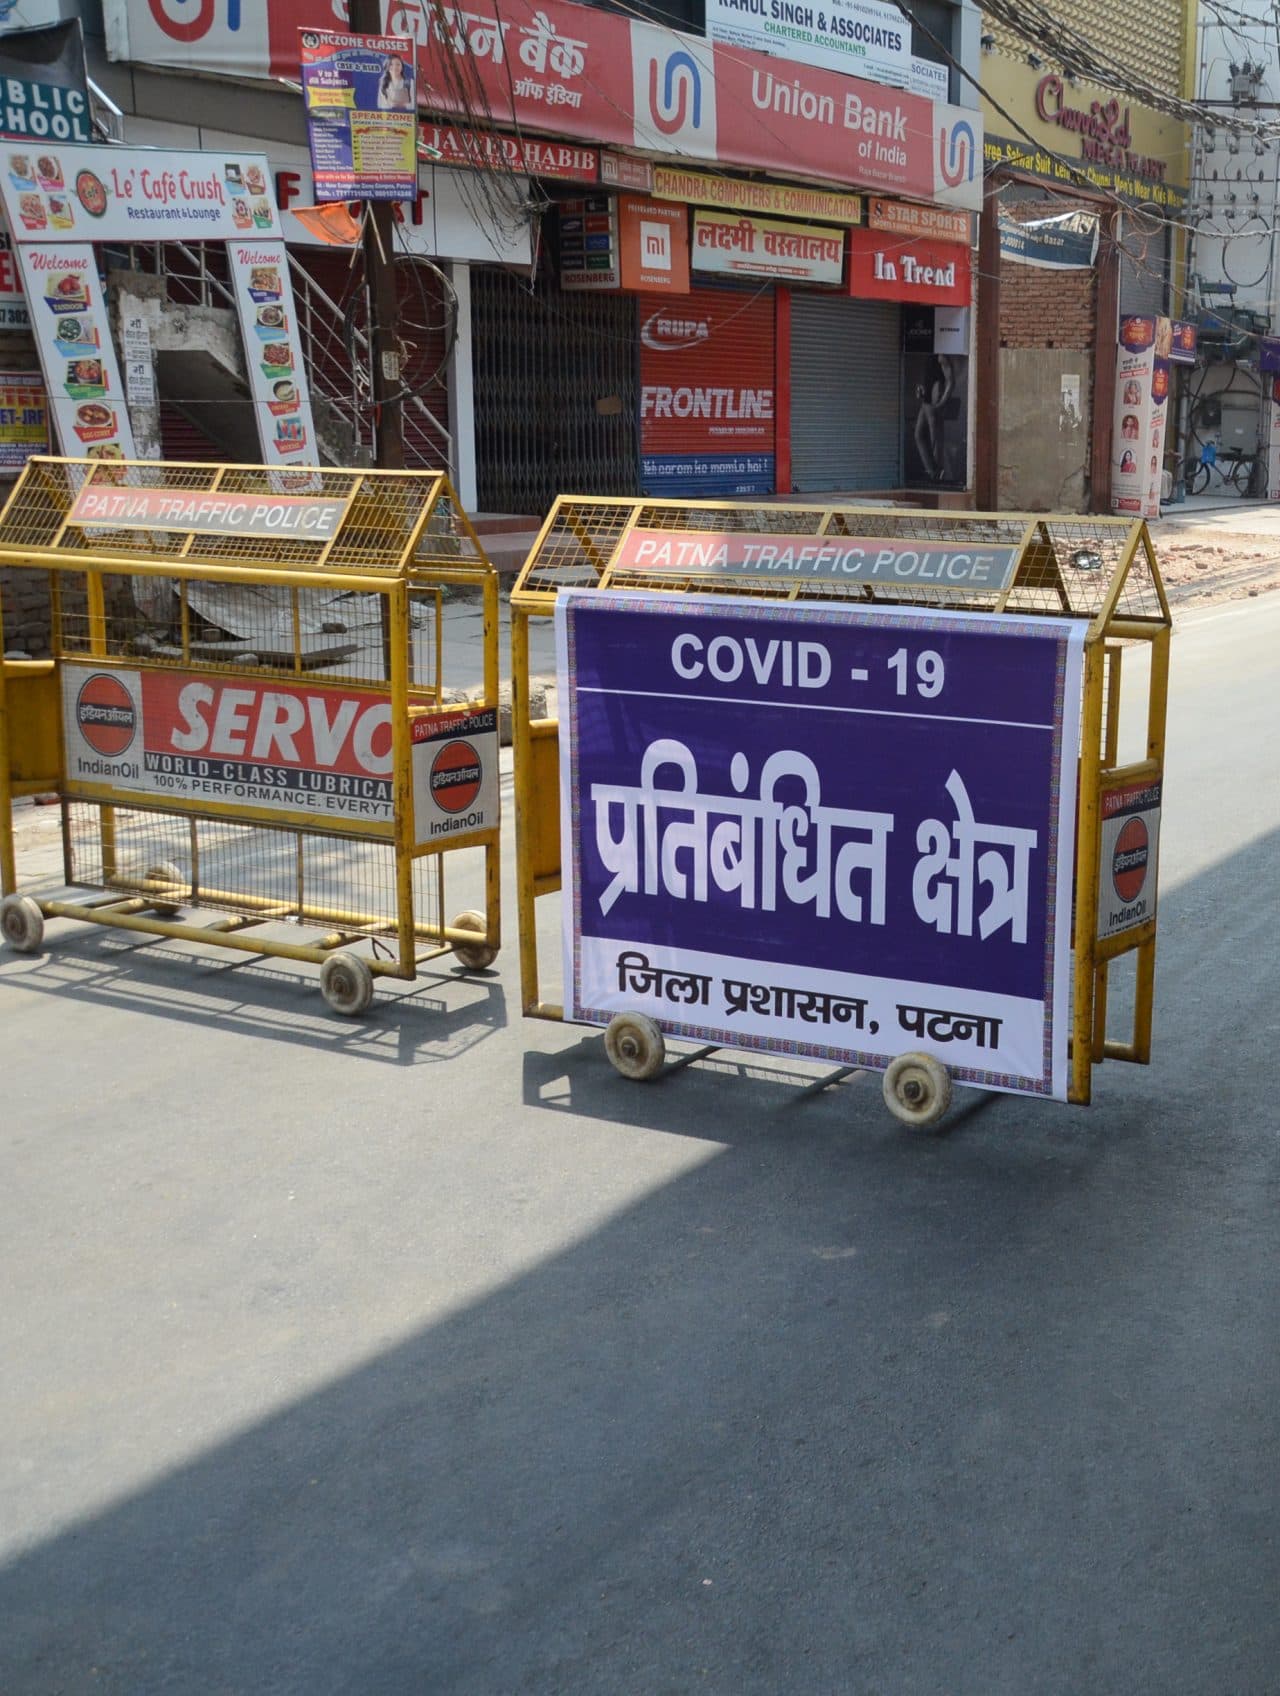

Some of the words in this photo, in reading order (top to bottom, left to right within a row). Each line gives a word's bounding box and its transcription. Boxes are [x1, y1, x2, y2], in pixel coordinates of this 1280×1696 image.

[764, 22, 812, 43] CHARTERED
[814, 35, 866, 57] ACCOUNTANTS
[771, 0, 813, 28] SINGH
[817, 16, 828, 31] &
[830, 15, 902, 51] ASSOCIATES
[366, 39, 409, 51] CLASSES
[911, 64, 946, 80] SOCIATES
[0, 78, 84, 114] BLIC
[513, 77, 544, 101] ऑफ
[545, 83, 583, 108] इंडिया
[752, 69, 834, 125] Union
[844, 93, 908, 142] Bank
[0, 106, 88, 141] HOOL
[351, 111, 383, 119] SPEAK
[386, 114, 412, 122] ZONE
[525, 143, 595, 170] HABIB
[858, 140, 873, 160] of
[874, 143, 908, 167] India
[140, 169, 176, 205] Café
[179, 170, 226, 207] Crush
[1007, 144, 1034, 170] Salwar
[1036, 152, 1052, 171] Suit
[1114, 174, 1133, 196] Men's
[1134, 180, 1150, 200] Wear
[654, 171, 708, 199] CHANDRA
[710, 180, 771, 208] COMPUTERS
[783, 192, 859, 219] COMMUNICATION
[886, 204, 919, 226] STAR
[921, 211, 967, 234] SPORTS
[30, 251, 88, 271] Welcome
[237, 248, 281, 265] Welcome
[762, 229, 842, 263] वस्त्रालय
[564, 272, 616, 284] ROSENBERG
[873, 251, 897, 281] In
[901, 255, 956, 288] Trend
[656, 319, 709, 337] RUPA
[0, 408, 44, 425] ET-JRF
[640, 386, 774, 418] FRONTLINE
[79, 494, 151, 520] PATNA
[156, 499, 247, 526] TRAFFIC
[248, 504, 337, 531] POLICE
[634, 539, 729, 568] PATNA
[739, 544, 864, 574] TRAFFIC
[872, 550, 996, 581] POLICE
[671, 633, 832, 689] COVID
[850, 667, 870, 682] -
[886, 646, 946, 699] 19
[171, 681, 394, 775] SERVO
[414, 721, 439, 737] PATNA
[439, 718, 468, 733] TRAFFIC
[468, 713, 494, 729] POLICE
[77, 757, 140, 781] IndianOil
[144, 754, 289, 788] WORLD-CLASS
[298, 771, 394, 800] LUBRICA
[152, 774, 188, 791] 100%
[191, 779, 322, 808] PERFORMANCE.
[325, 793, 395, 817] EVERYT
[430, 811, 484, 835] IndianOil
[590, 738, 894, 927] प्रतिबंधित
[911, 767, 1038, 944] क्षेत्र
[1108, 899, 1147, 927] IndianOil
[616, 950, 711, 1006] जिला
[721, 976, 881, 1037] प्रशासन,
[895, 1001, 1003, 1051] पटना
